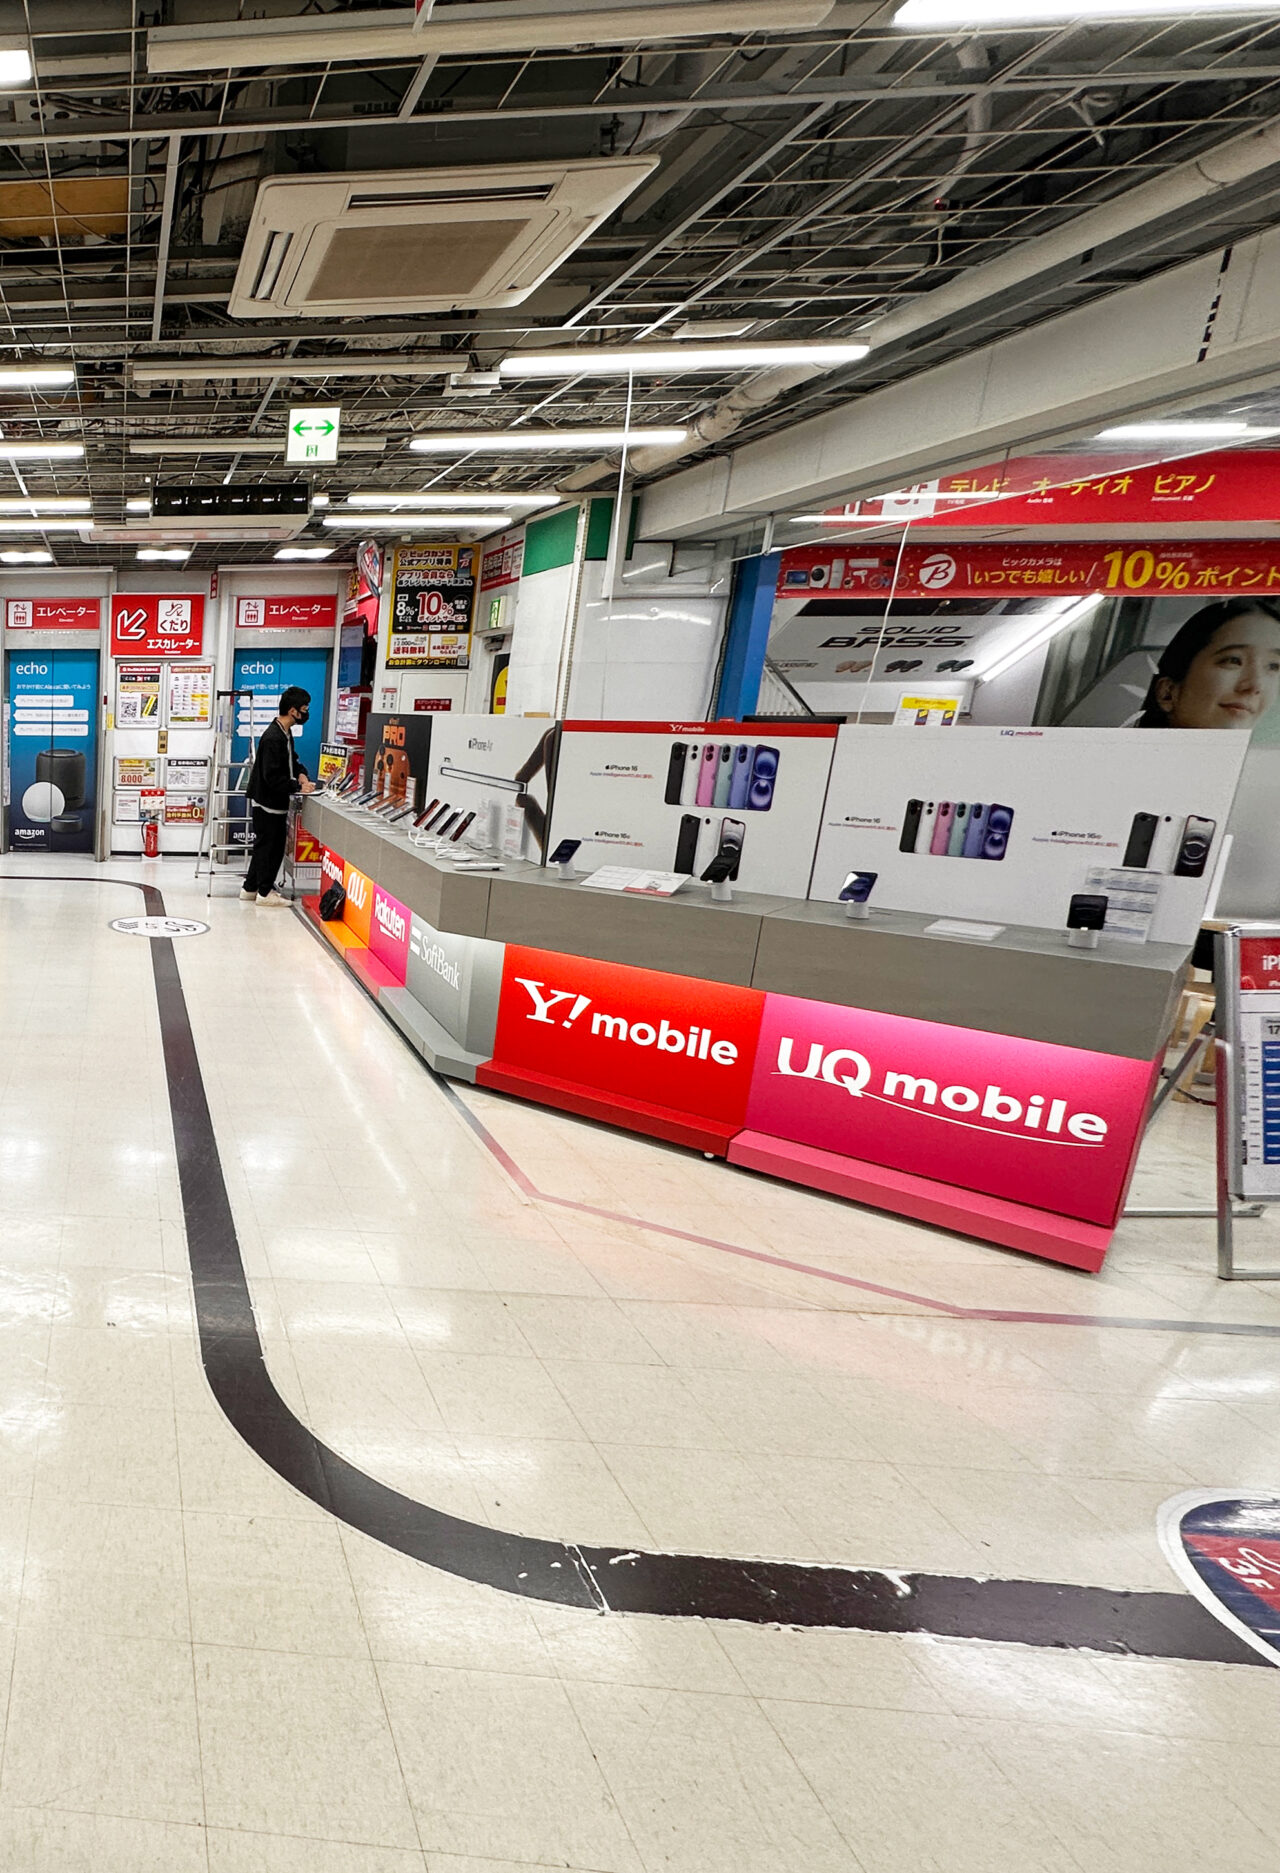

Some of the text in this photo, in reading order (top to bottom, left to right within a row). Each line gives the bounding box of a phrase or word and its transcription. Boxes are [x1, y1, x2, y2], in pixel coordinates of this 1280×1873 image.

[1031, 475, 1133, 496] オーディオ
[1153, 473, 1216, 494] ピアノ
[1001, 557, 1062, 567] ビックカメラは
[1103, 549, 1280, 590] 10% ポイント
[973, 567, 1085, 586] いつでも嬉しい
[36, 605, 97, 617] エレベーター
[268, 603, 332, 615] エレベーター
[416, 591, 454, 616] 10%
[856, 625, 963, 635] SOLID
[146, 639, 200, 650] エスカレーター
[817, 635, 974, 649] BASS
[15, 661, 48, 675] echo
[240, 661, 274, 675] echo
[382, 725, 406, 747] PRO
[14, 829, 45, 838] amazon
[599, 831, 619, 839] iPhone
[346, 871, 368, 911] au
[375, 893, 406, 943] Rakuten
[420, 934, 461, 991] SoftBank
[514, 976, 739, 1067] Y! mobile
[771, 1036, 1109, 1143] UQ mobile
